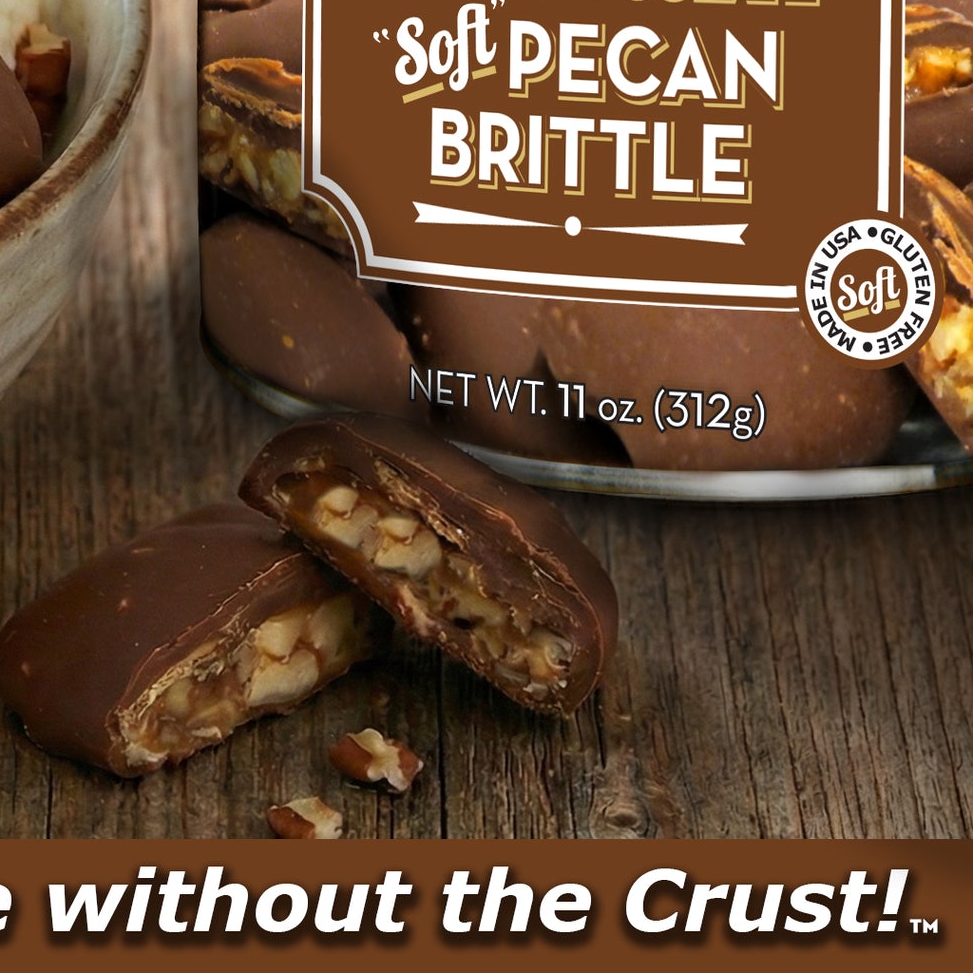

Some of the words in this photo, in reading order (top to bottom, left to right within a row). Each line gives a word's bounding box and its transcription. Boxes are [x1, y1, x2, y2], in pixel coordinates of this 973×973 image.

[508, 19, 784, 110] PECAN
[430, 107, 752, 204] BRITTLE
[821, 225, 862, 259] USA
[880, 227, 931, 306] GLUTEN
[811, 262, 829, 290] IN
[837, 266, 901, 314] Soft
[811, 296, 856, 352] MADE
[876, 311, 924, 355] FREE
[408, 364, 477, 407] NET
[485, 375, 547, 416] WT.
[557, 382, 586, 419] 11
[597, 397, 643, 424] oz.
[654, 388, 766, 440] (312g)
